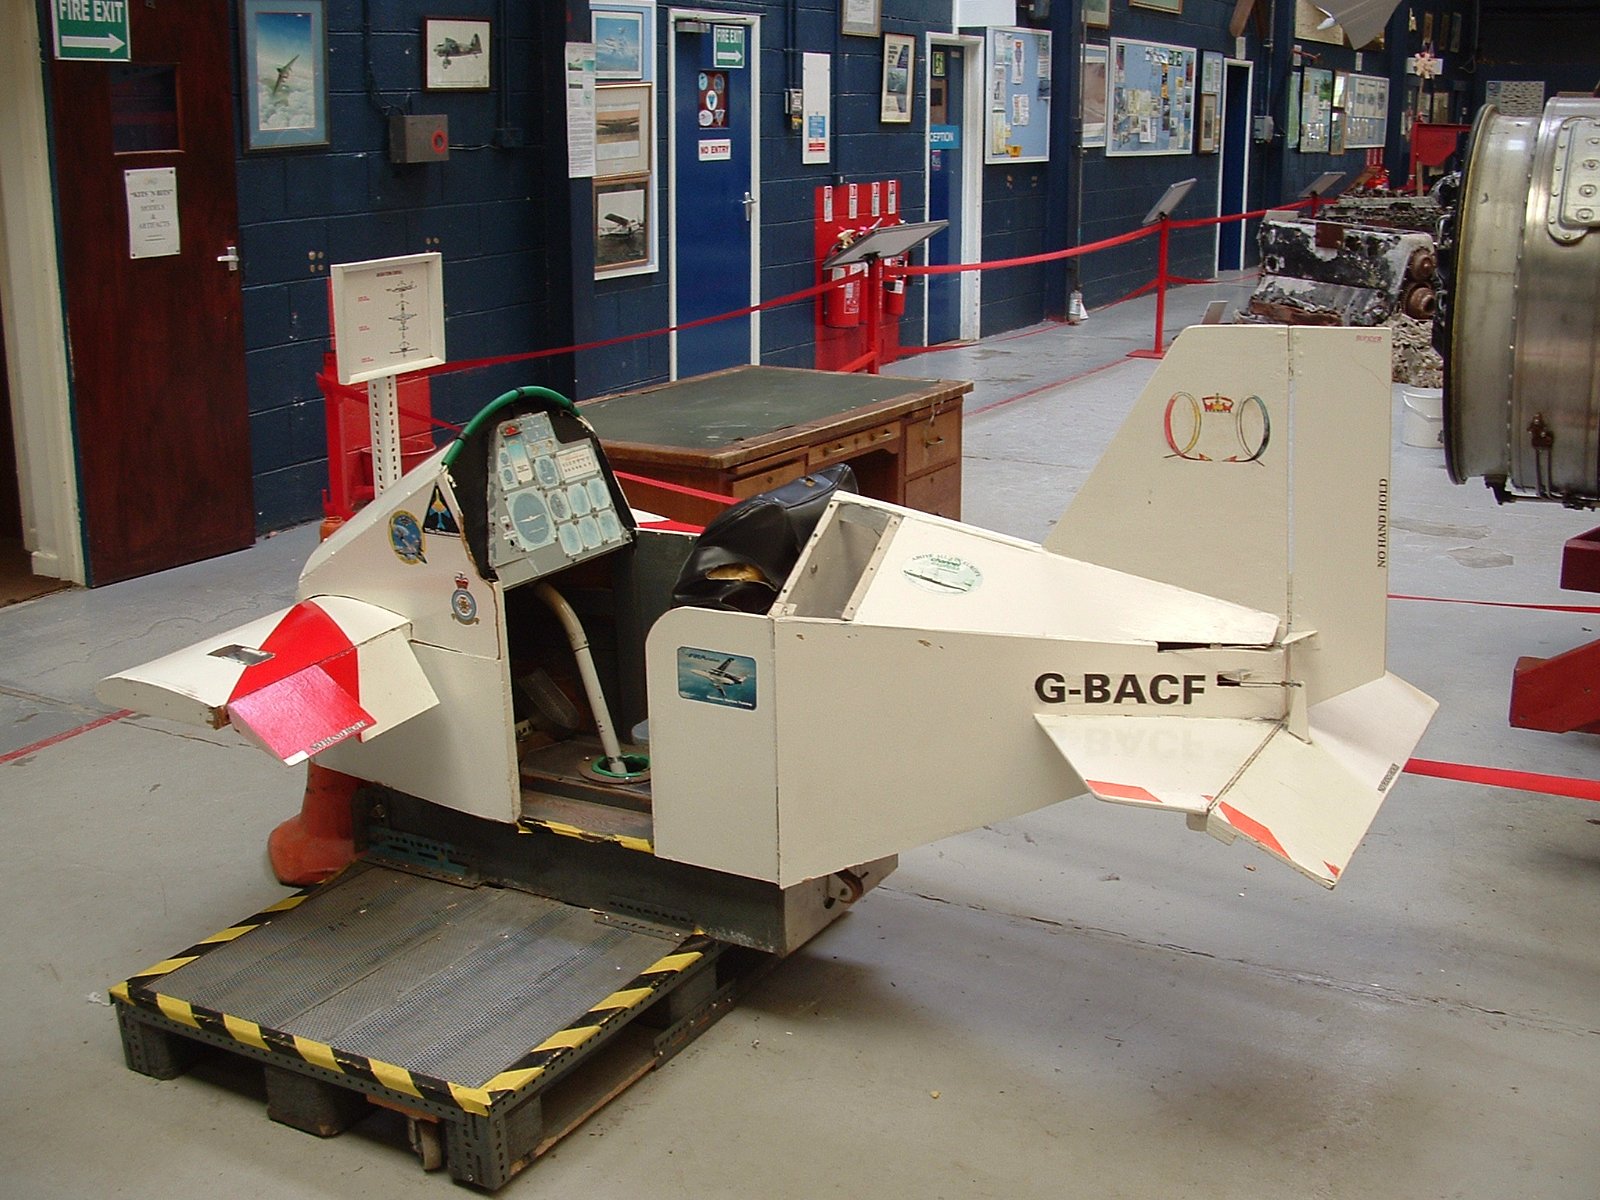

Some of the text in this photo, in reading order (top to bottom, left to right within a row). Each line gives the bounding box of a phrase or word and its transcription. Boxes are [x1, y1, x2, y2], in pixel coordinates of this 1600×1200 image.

[59, 0, 123, 23] FIRE EXIT
[716, 29, 742, 43] FIRE EXIT
[930, 132, 953, 142] CEPTION
[700, 145, 729, 154] NO ENTRY
[1378, 479, 1388, 568] NO HAND HOLD
[1034, 673, 1206, 705] G-BACF
